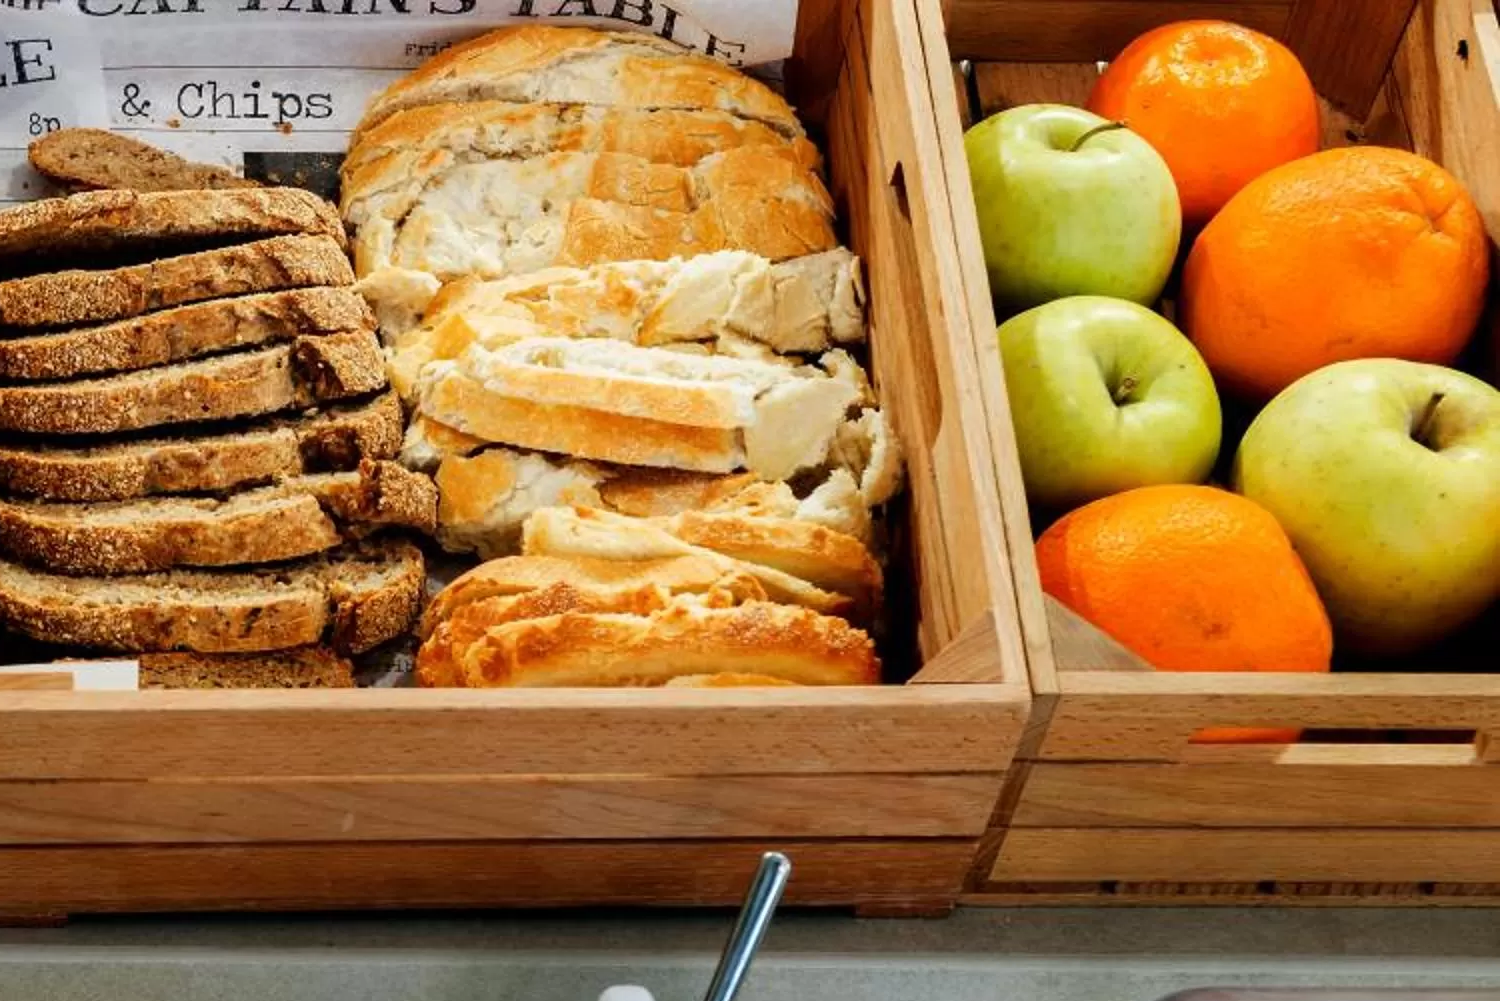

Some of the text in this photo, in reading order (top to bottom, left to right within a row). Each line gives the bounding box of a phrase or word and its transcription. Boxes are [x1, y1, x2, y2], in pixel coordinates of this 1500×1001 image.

[405, 41, 453, 57] Frid
[121, 80, 334, 126] & Chips
